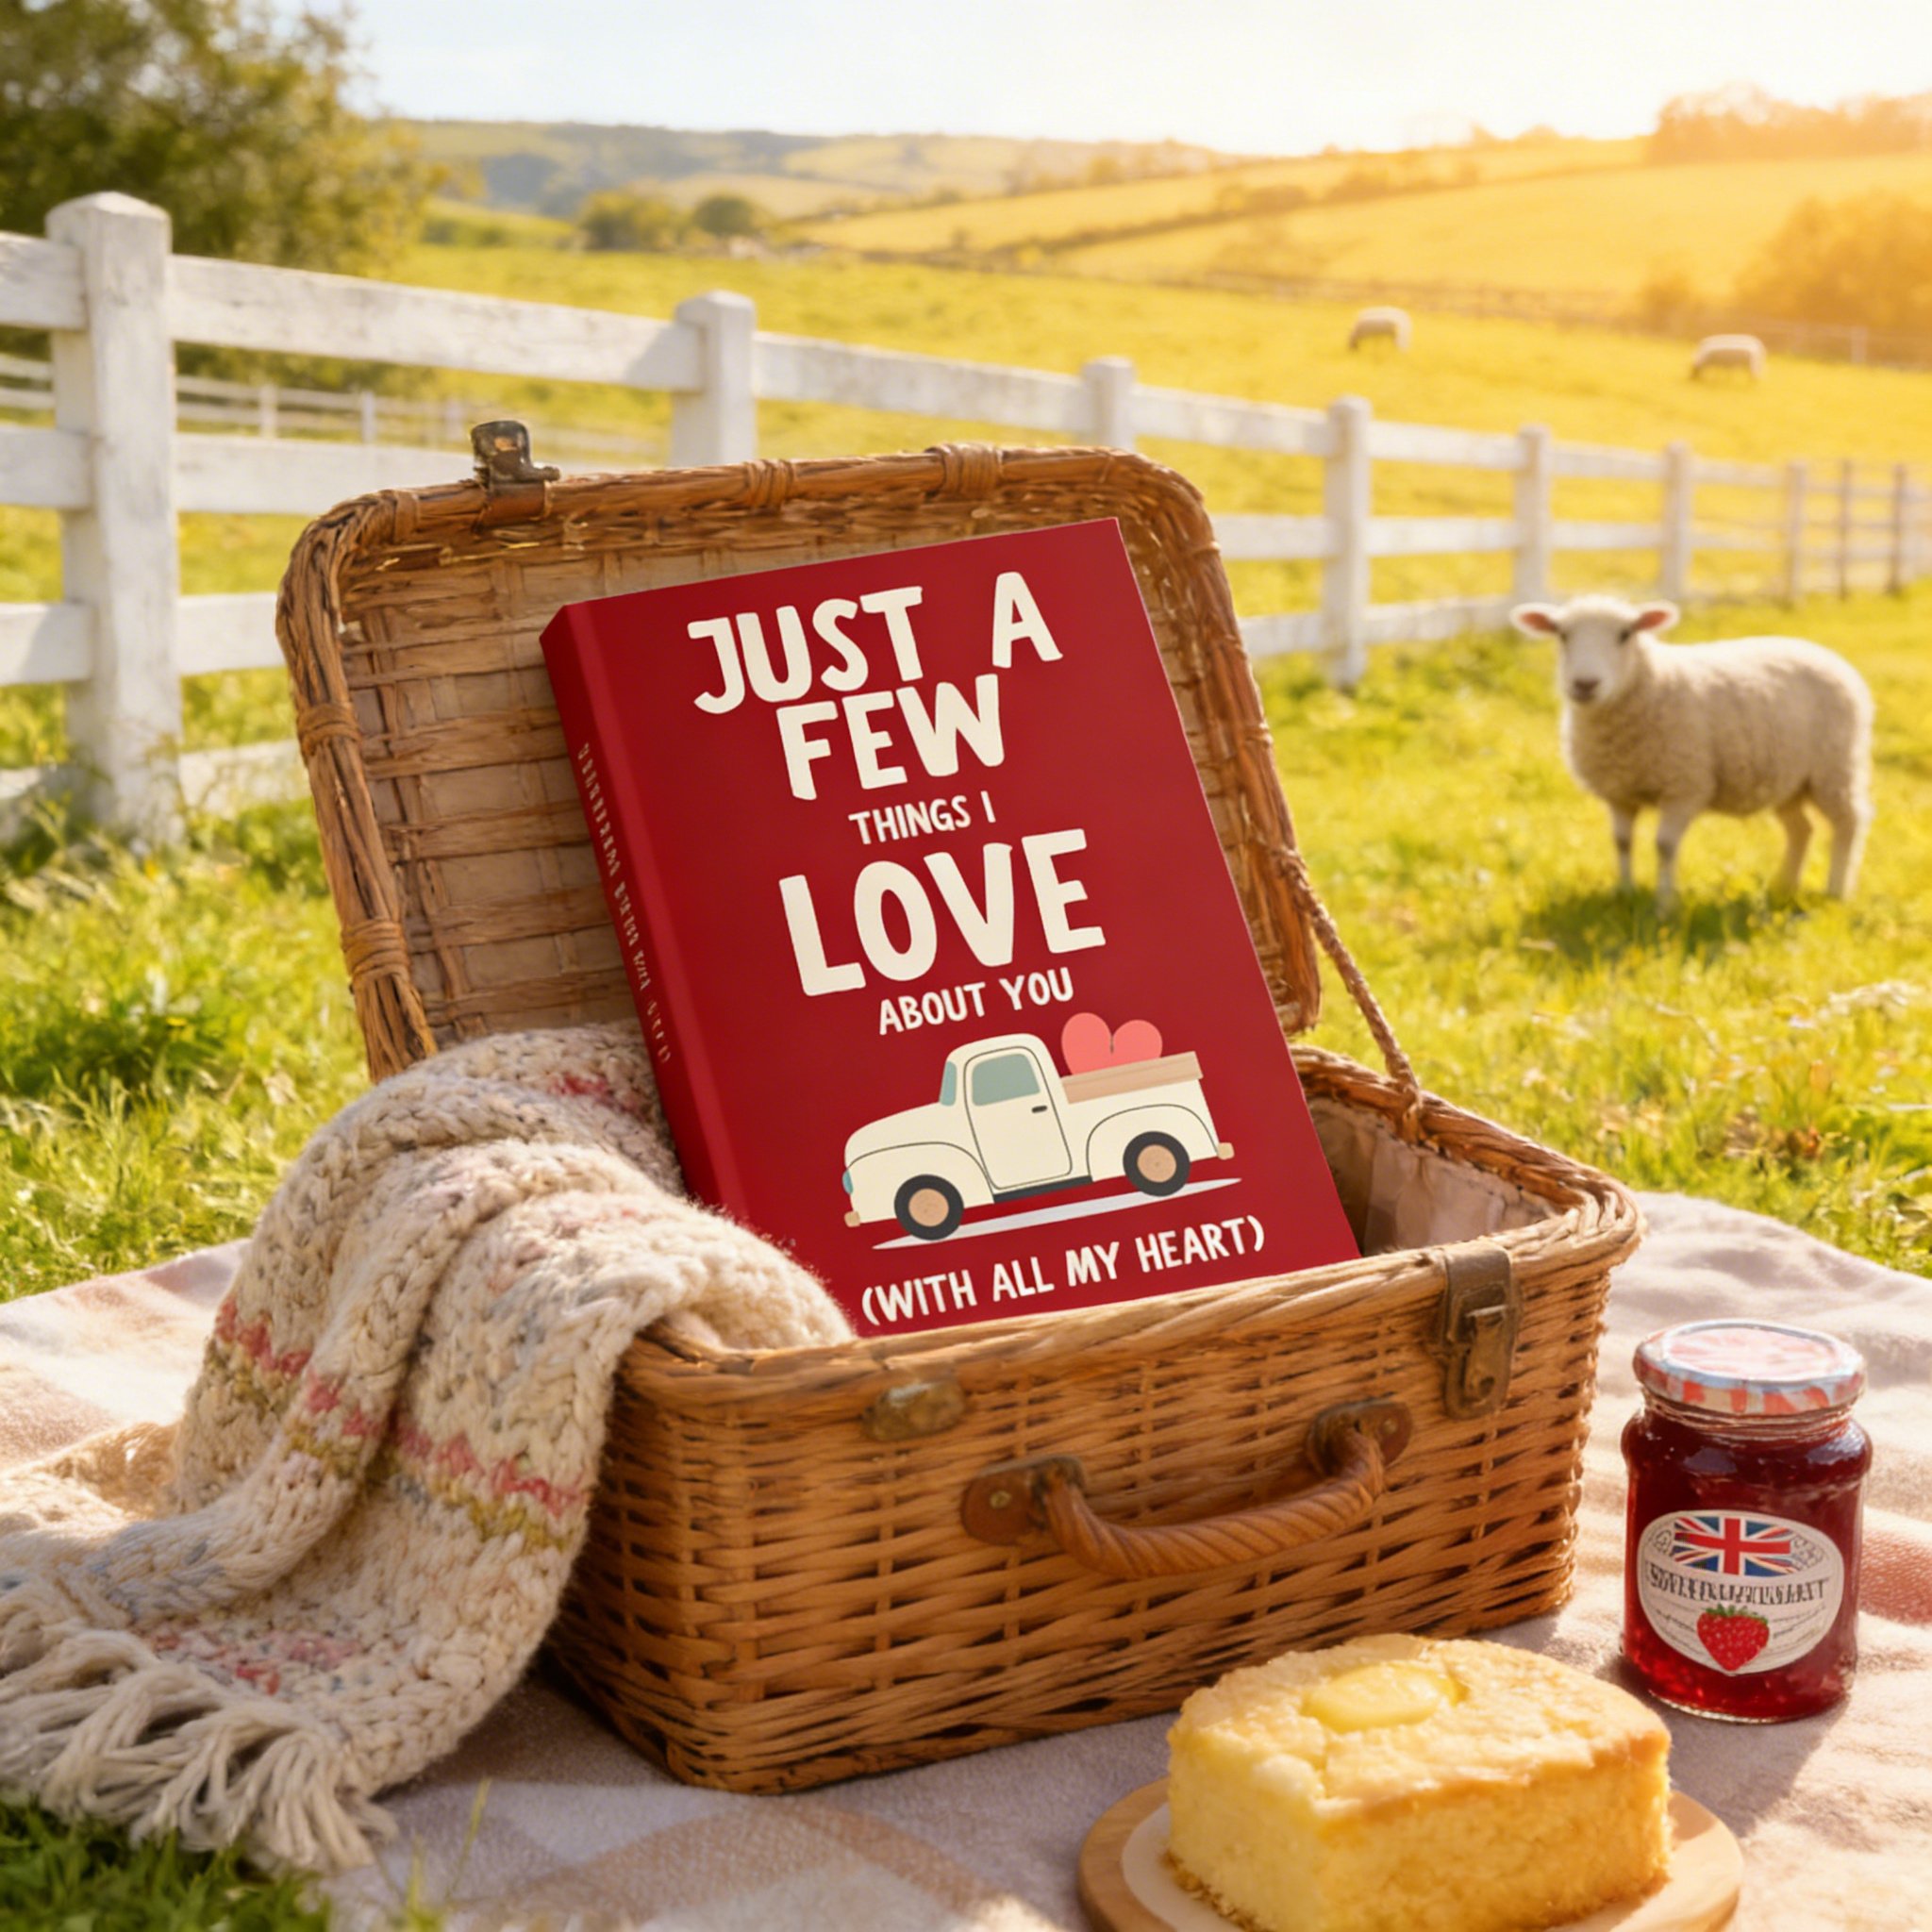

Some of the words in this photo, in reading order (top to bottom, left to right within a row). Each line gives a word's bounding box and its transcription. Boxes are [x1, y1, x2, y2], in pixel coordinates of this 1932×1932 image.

[688, 586, 923, 714] JUST
[992, 572, 1063, 669] A
[776, 674, 1004, 800] FEW
[848, 795, 972, 845] THINGS
[980, 791, 996, 824] I
[779, 829, 1107, 997] LOVE
[879, 982, 986, 1036] ABOUT
[999, 967, 1074, 1011] YOU
[861, 1270, 977, 1327] (WITH
[992, 1257, 1055, 1302] ALL
[1066, 1241, 1120, 1287] MY
[1135, 1214, 1266, 1274] HEART)
